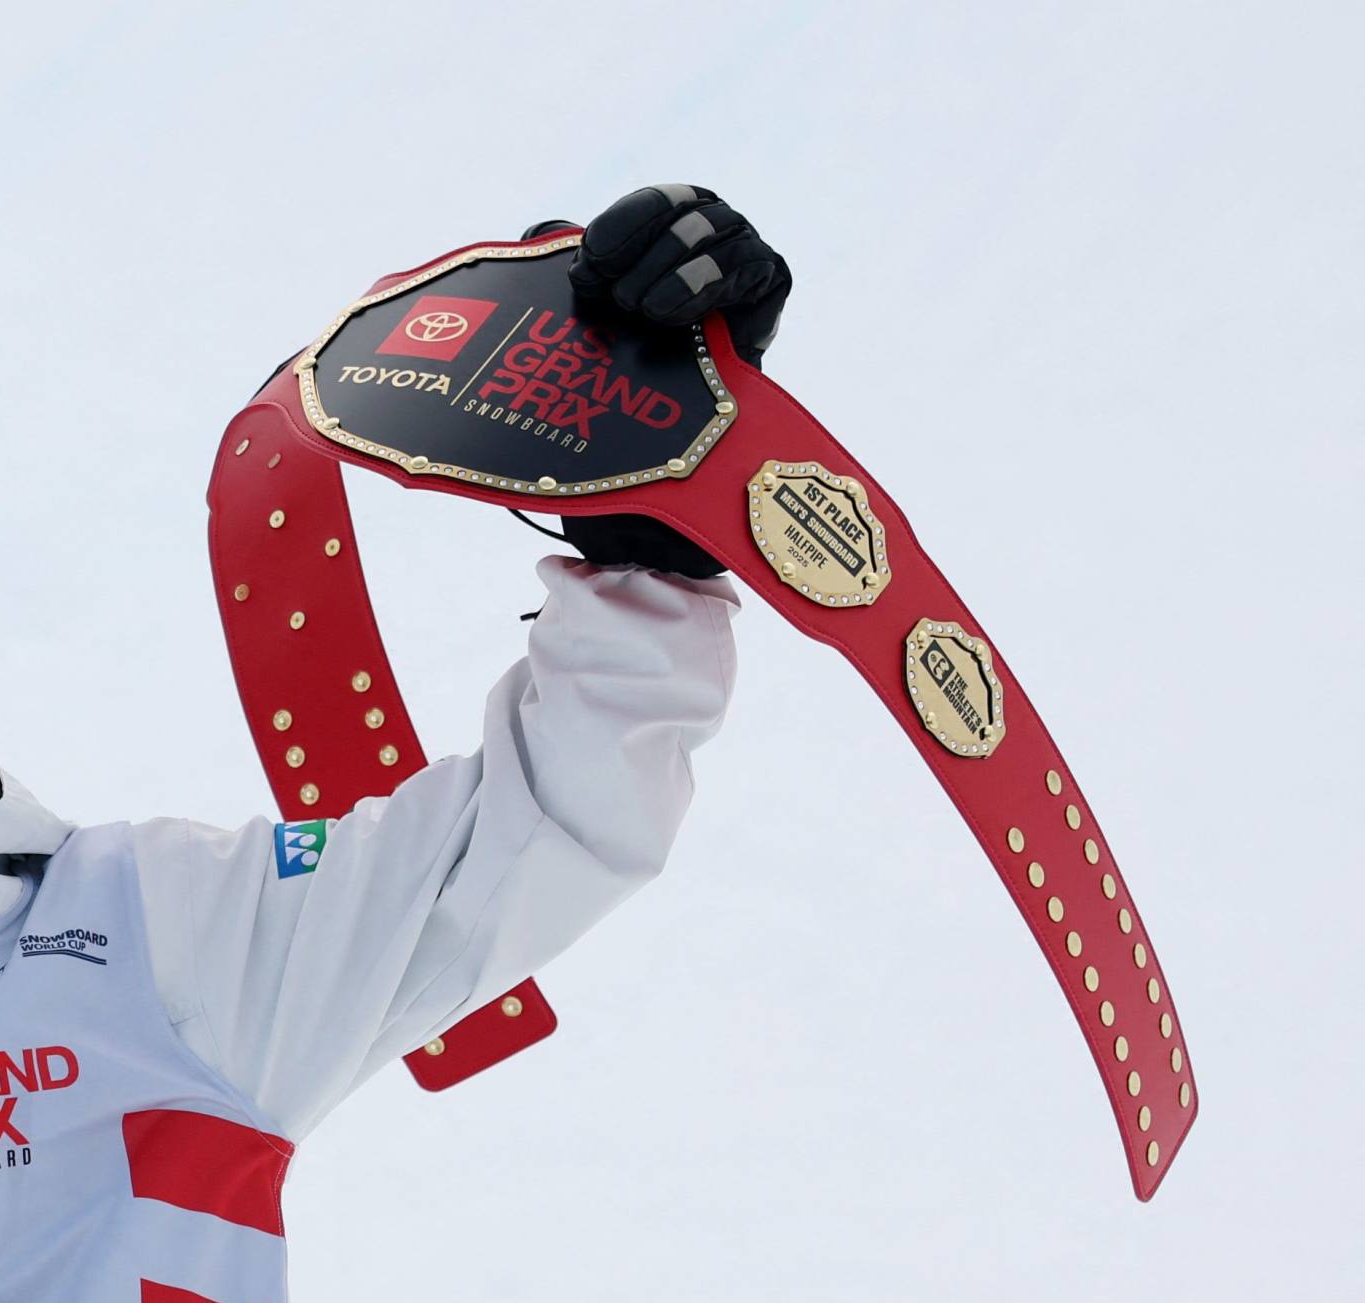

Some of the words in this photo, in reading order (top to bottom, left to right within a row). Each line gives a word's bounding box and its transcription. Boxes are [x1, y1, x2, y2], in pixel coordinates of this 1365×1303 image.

[528, 310, 618, 367] U.S.
[337, 365, 453, 396] TOYOTA
[503, 343, 683, 430] GRAND
[464, 399, 589, 455] SNOWBOARD
[479, 371, 612, 441] PRIX
[780, 491, 809, 519] MEN'S
[807, 517, 858, 568] SNOWBOARD
[803, 482, 828, 507] 1ST
[824, 502, 865, 544] PLACE
[784, 525, 828, 569] HALFPIPE
[787, 546, 809, 567] 2025
[948, 680, 982, 727] ATHLETE'S
[954, 672, 968, 691] THE
[943, 686, 977, 734] MOUNTAIN
[19, 929, 108, 947] SNOWBOARD
[21, 941, 67, 951] WORLD
[68, 940, 86, 951] CUP
